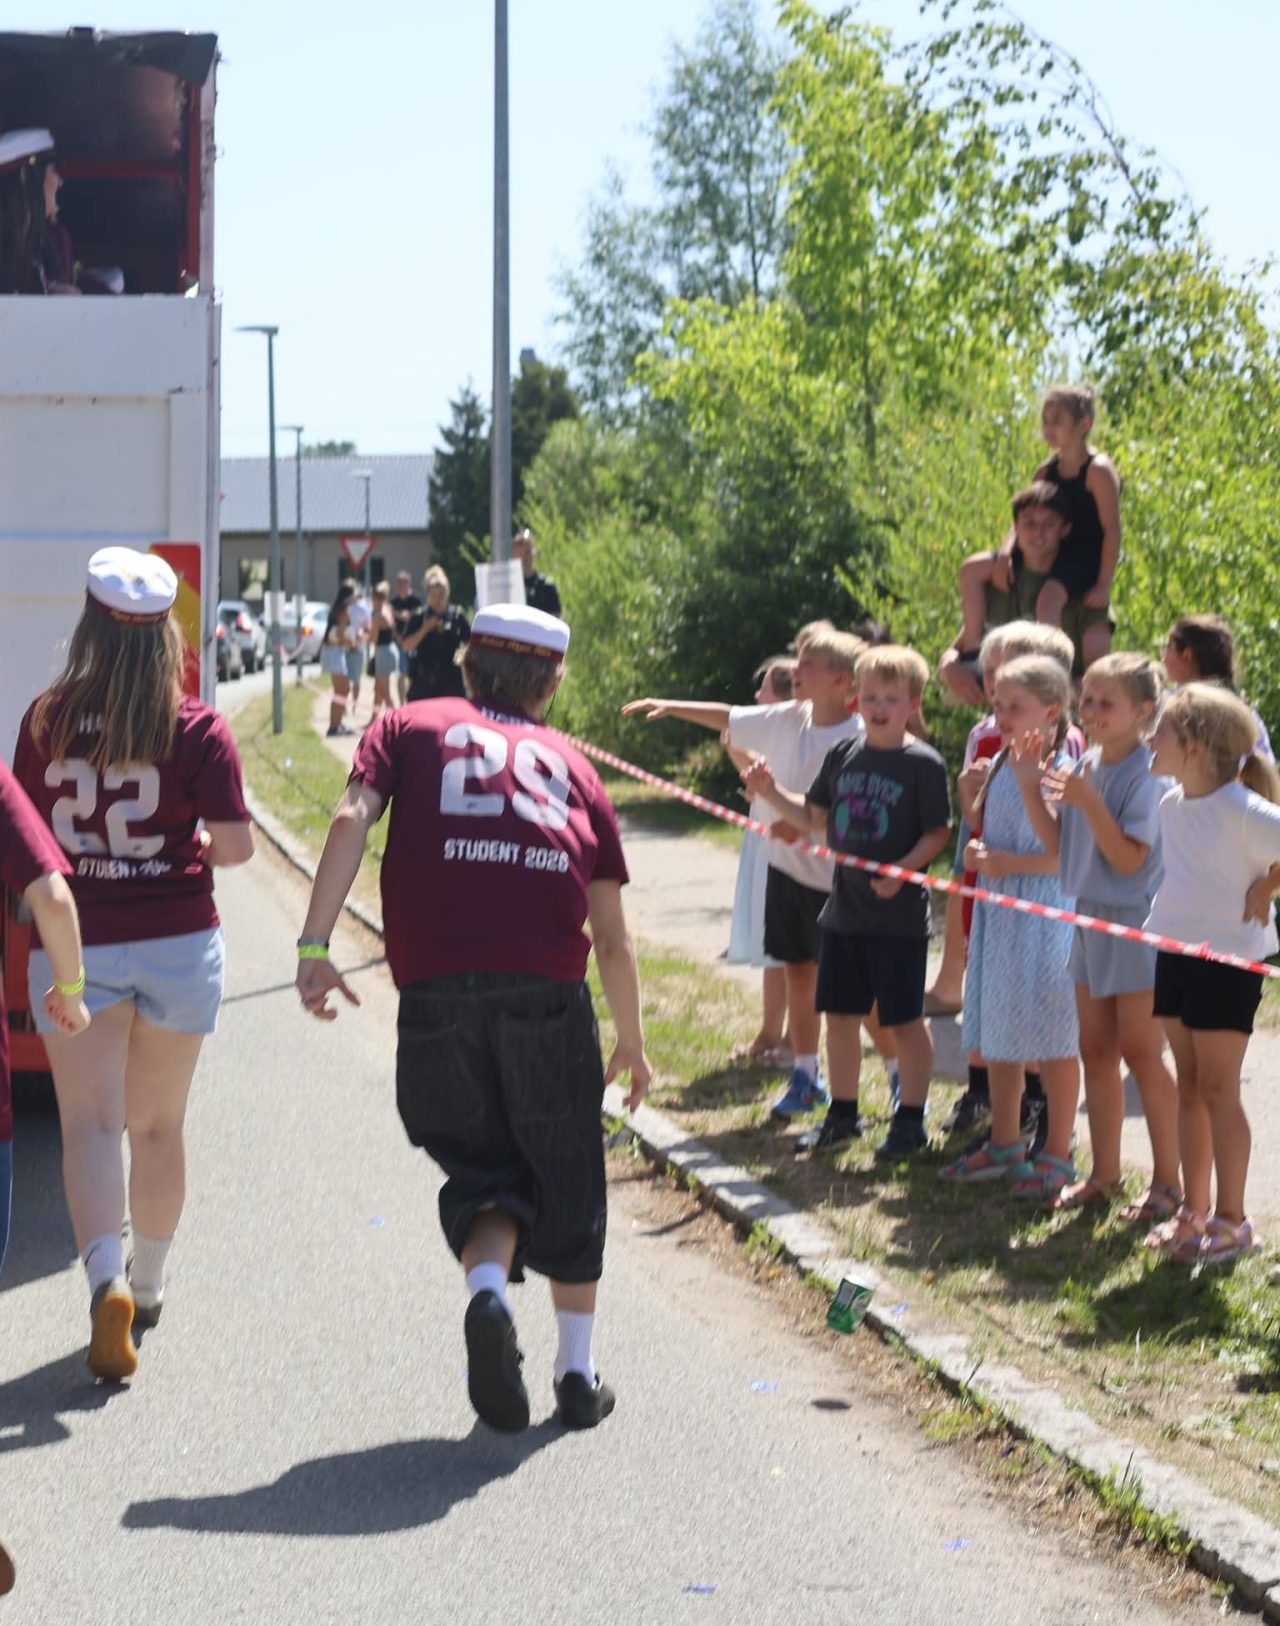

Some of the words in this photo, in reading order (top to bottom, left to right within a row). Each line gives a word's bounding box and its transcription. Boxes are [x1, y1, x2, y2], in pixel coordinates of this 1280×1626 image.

[44, 757, 165, 859] 22
[440, 722, 572, 831] 29
[444, 838, 521, 865] STUDENT
